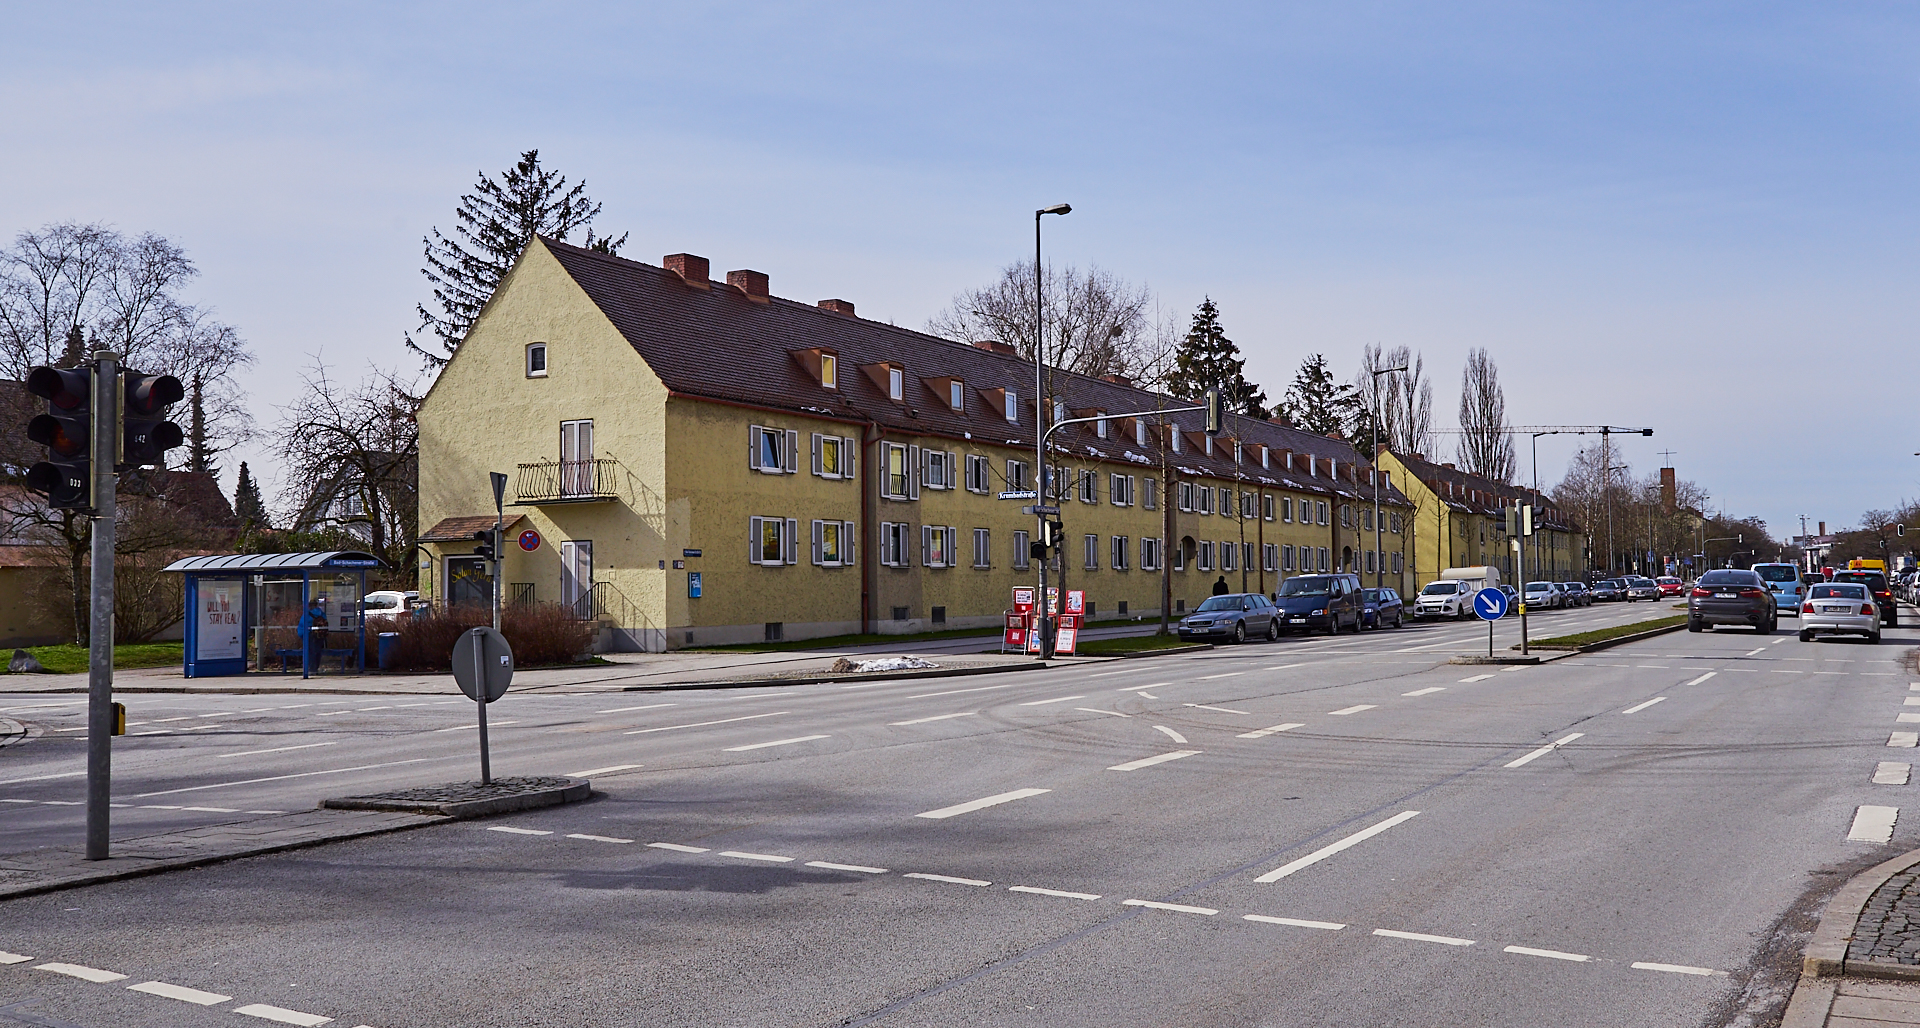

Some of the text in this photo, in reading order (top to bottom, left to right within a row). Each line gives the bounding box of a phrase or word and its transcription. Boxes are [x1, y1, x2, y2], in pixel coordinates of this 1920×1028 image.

[451, 565, 472, 584] Salon
[207, 600, 230, 612] WILL YOU
[209, 613, 222, 625] STAY
